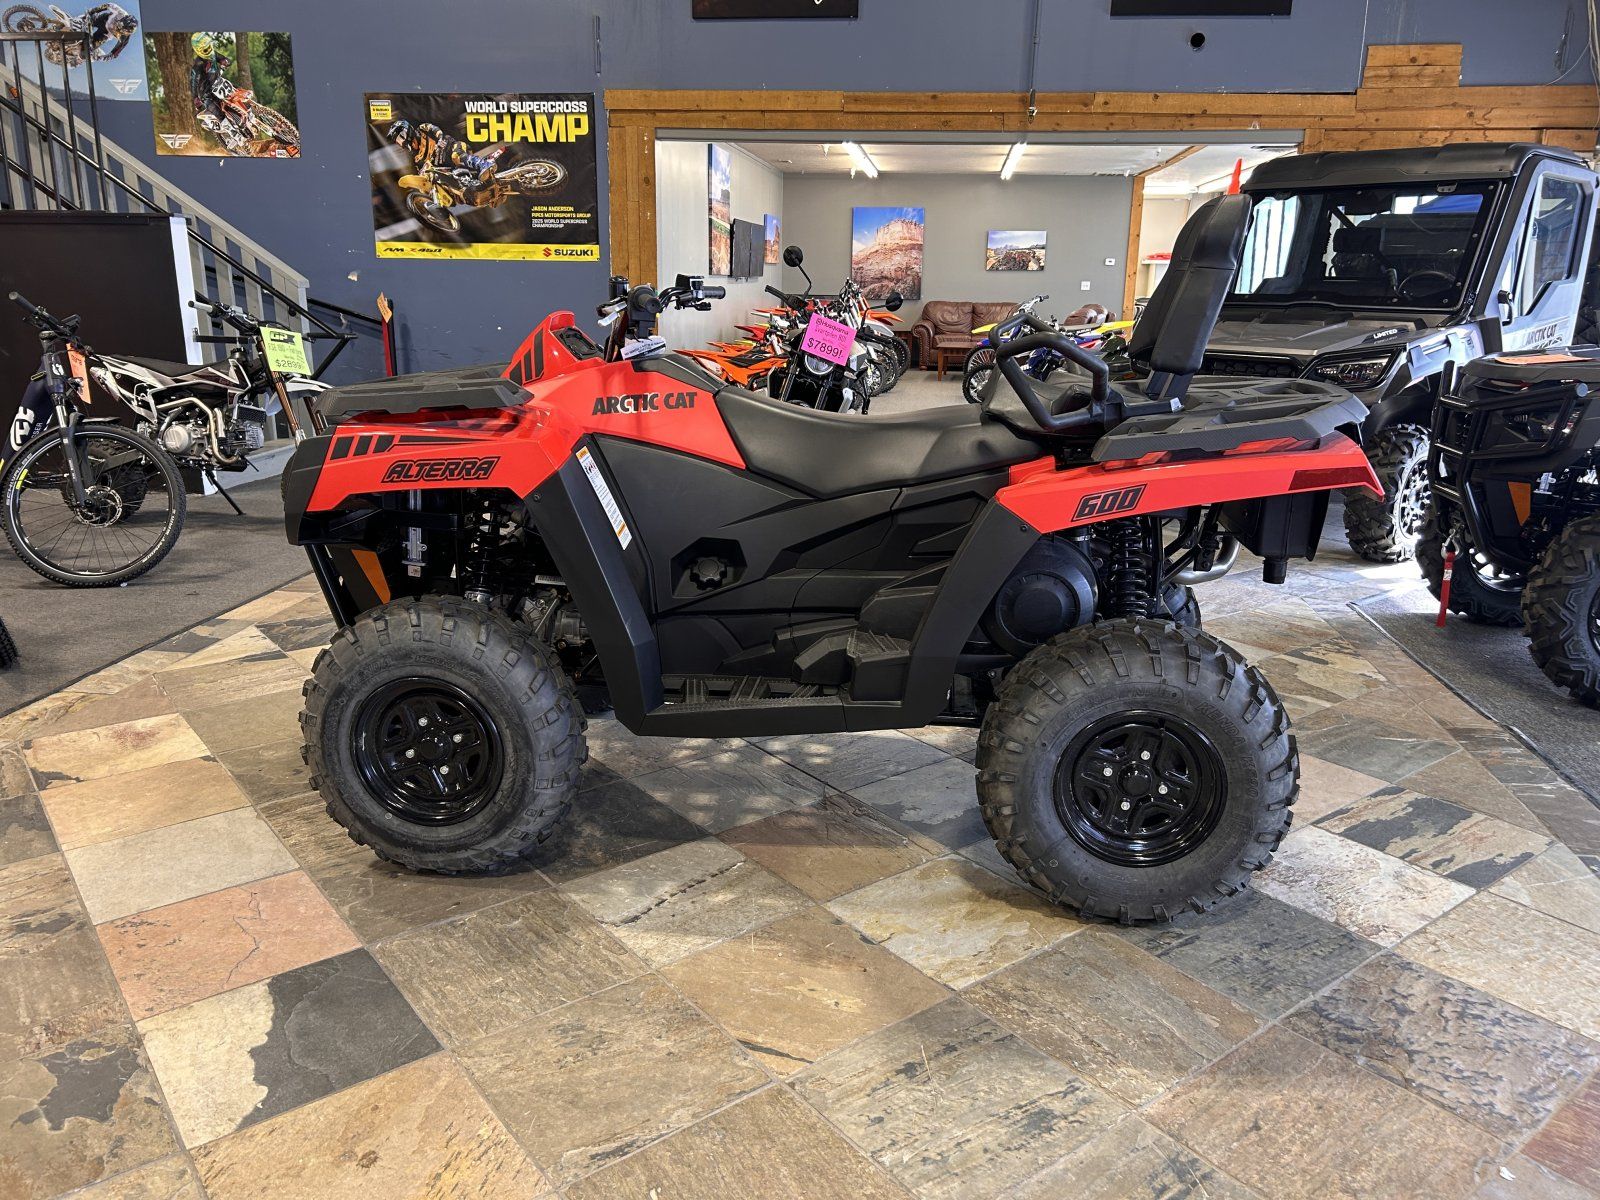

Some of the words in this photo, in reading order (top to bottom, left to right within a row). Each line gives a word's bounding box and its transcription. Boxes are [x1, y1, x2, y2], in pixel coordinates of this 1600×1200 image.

[465, 101, 507, 113] WORLD
[510, 101, 588, 113] SUPERCROSS
[466, 113, 589, 143] CHAMP
[554, 248, 594, 257] SUZUKI
[1373, 328, 1398, 339] LIMITED
[1546, 323, 1558, 339] CAT
[807, 337, 843, 359] $7899!
[591, 392, 660, 415] ARCTIC
[663, 391, 698, 410] CAT
[383, 457, 499, 482] ALTERRA
[1073, 485, 1146, 520] 600
[1195, 702, 1247, 747] KENDA
